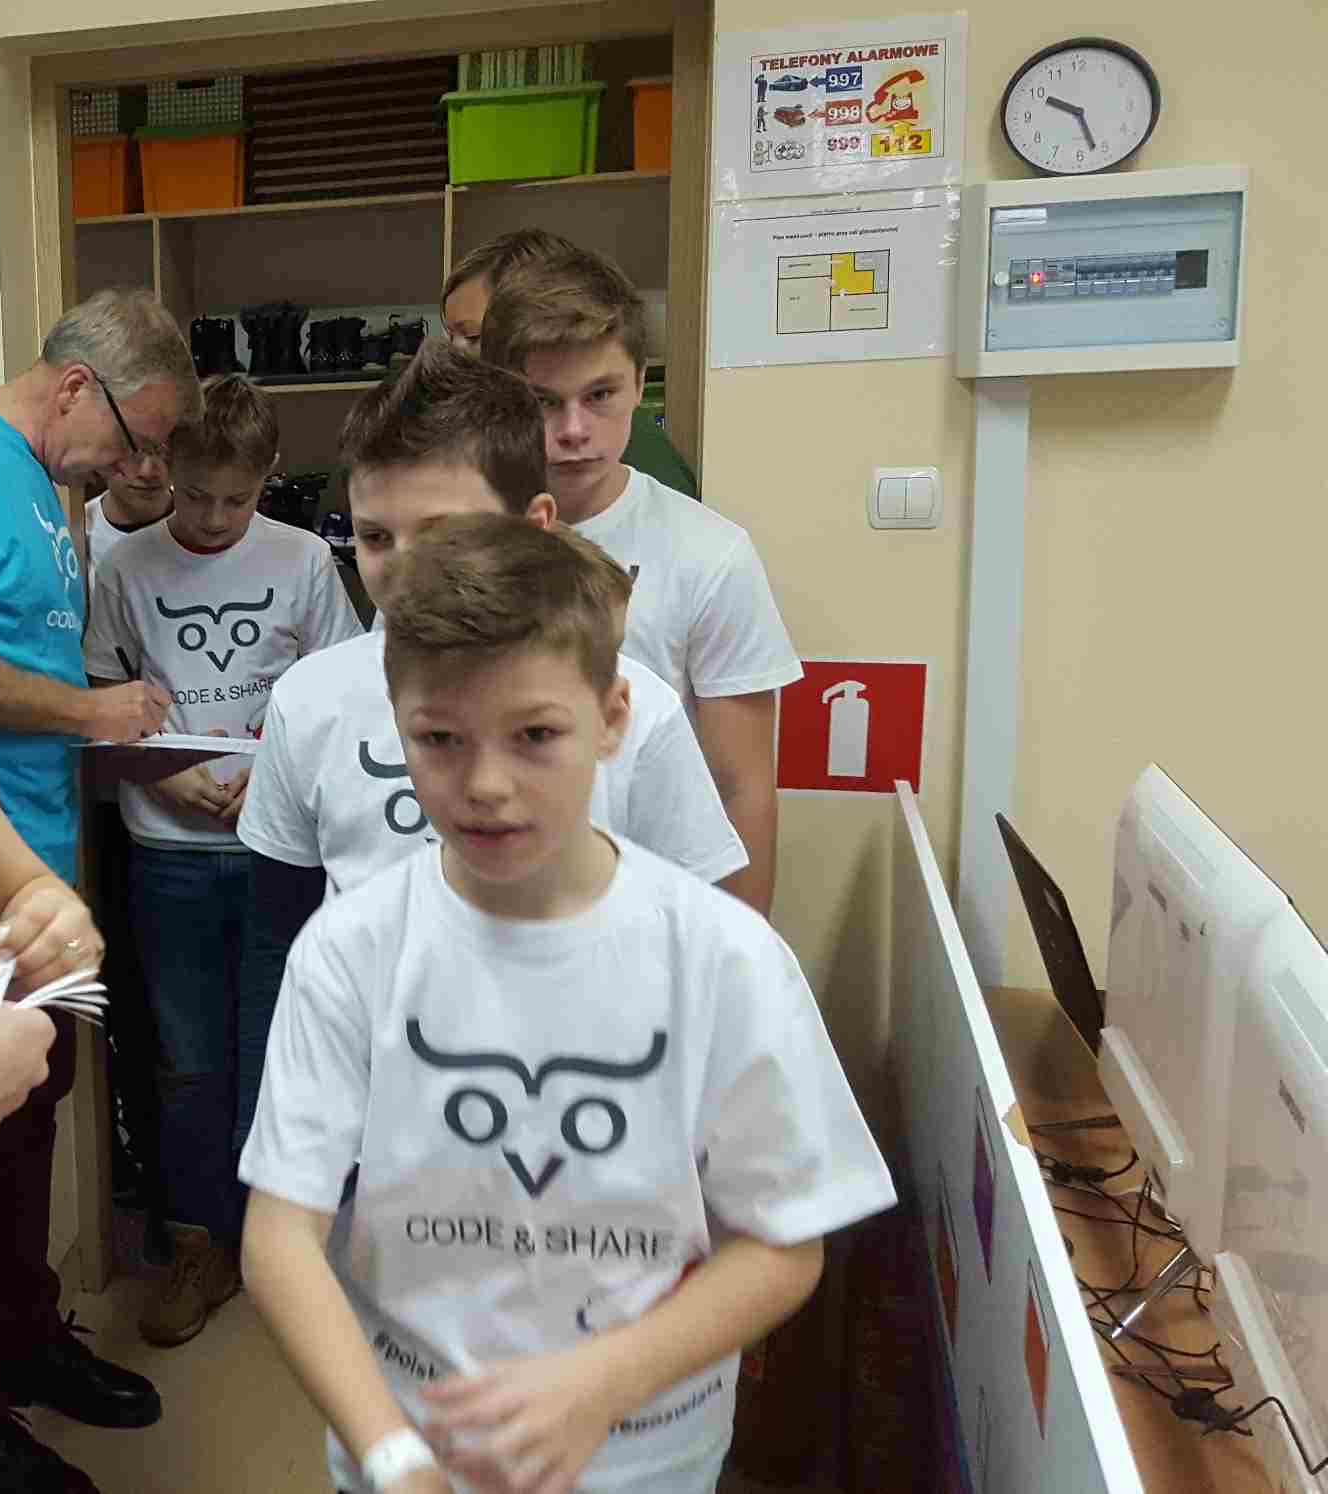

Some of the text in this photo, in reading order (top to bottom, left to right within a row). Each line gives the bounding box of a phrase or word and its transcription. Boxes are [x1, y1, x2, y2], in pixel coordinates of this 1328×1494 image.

[760, 44, 939, 71] TELEFONY ALARMOWE
[829, 71, 860, 88] 997
[1030, 86, 1045, 99] 10
[828, 105, 860, 120] 998
[1024, 110, 1032, 123] 9
[827, 136, 860, 151] 999
[880, 134, 923, 153] 112
[1033, 131, 1041, 144] 8
[1076, 150, 1085, 163] 6
[47, 610, 81, 631] COD
[174, 688, 210, 705] ODE
[213, 687, 226, 702] &
[405, 1214, 673, 1262] CODE & SHARE
